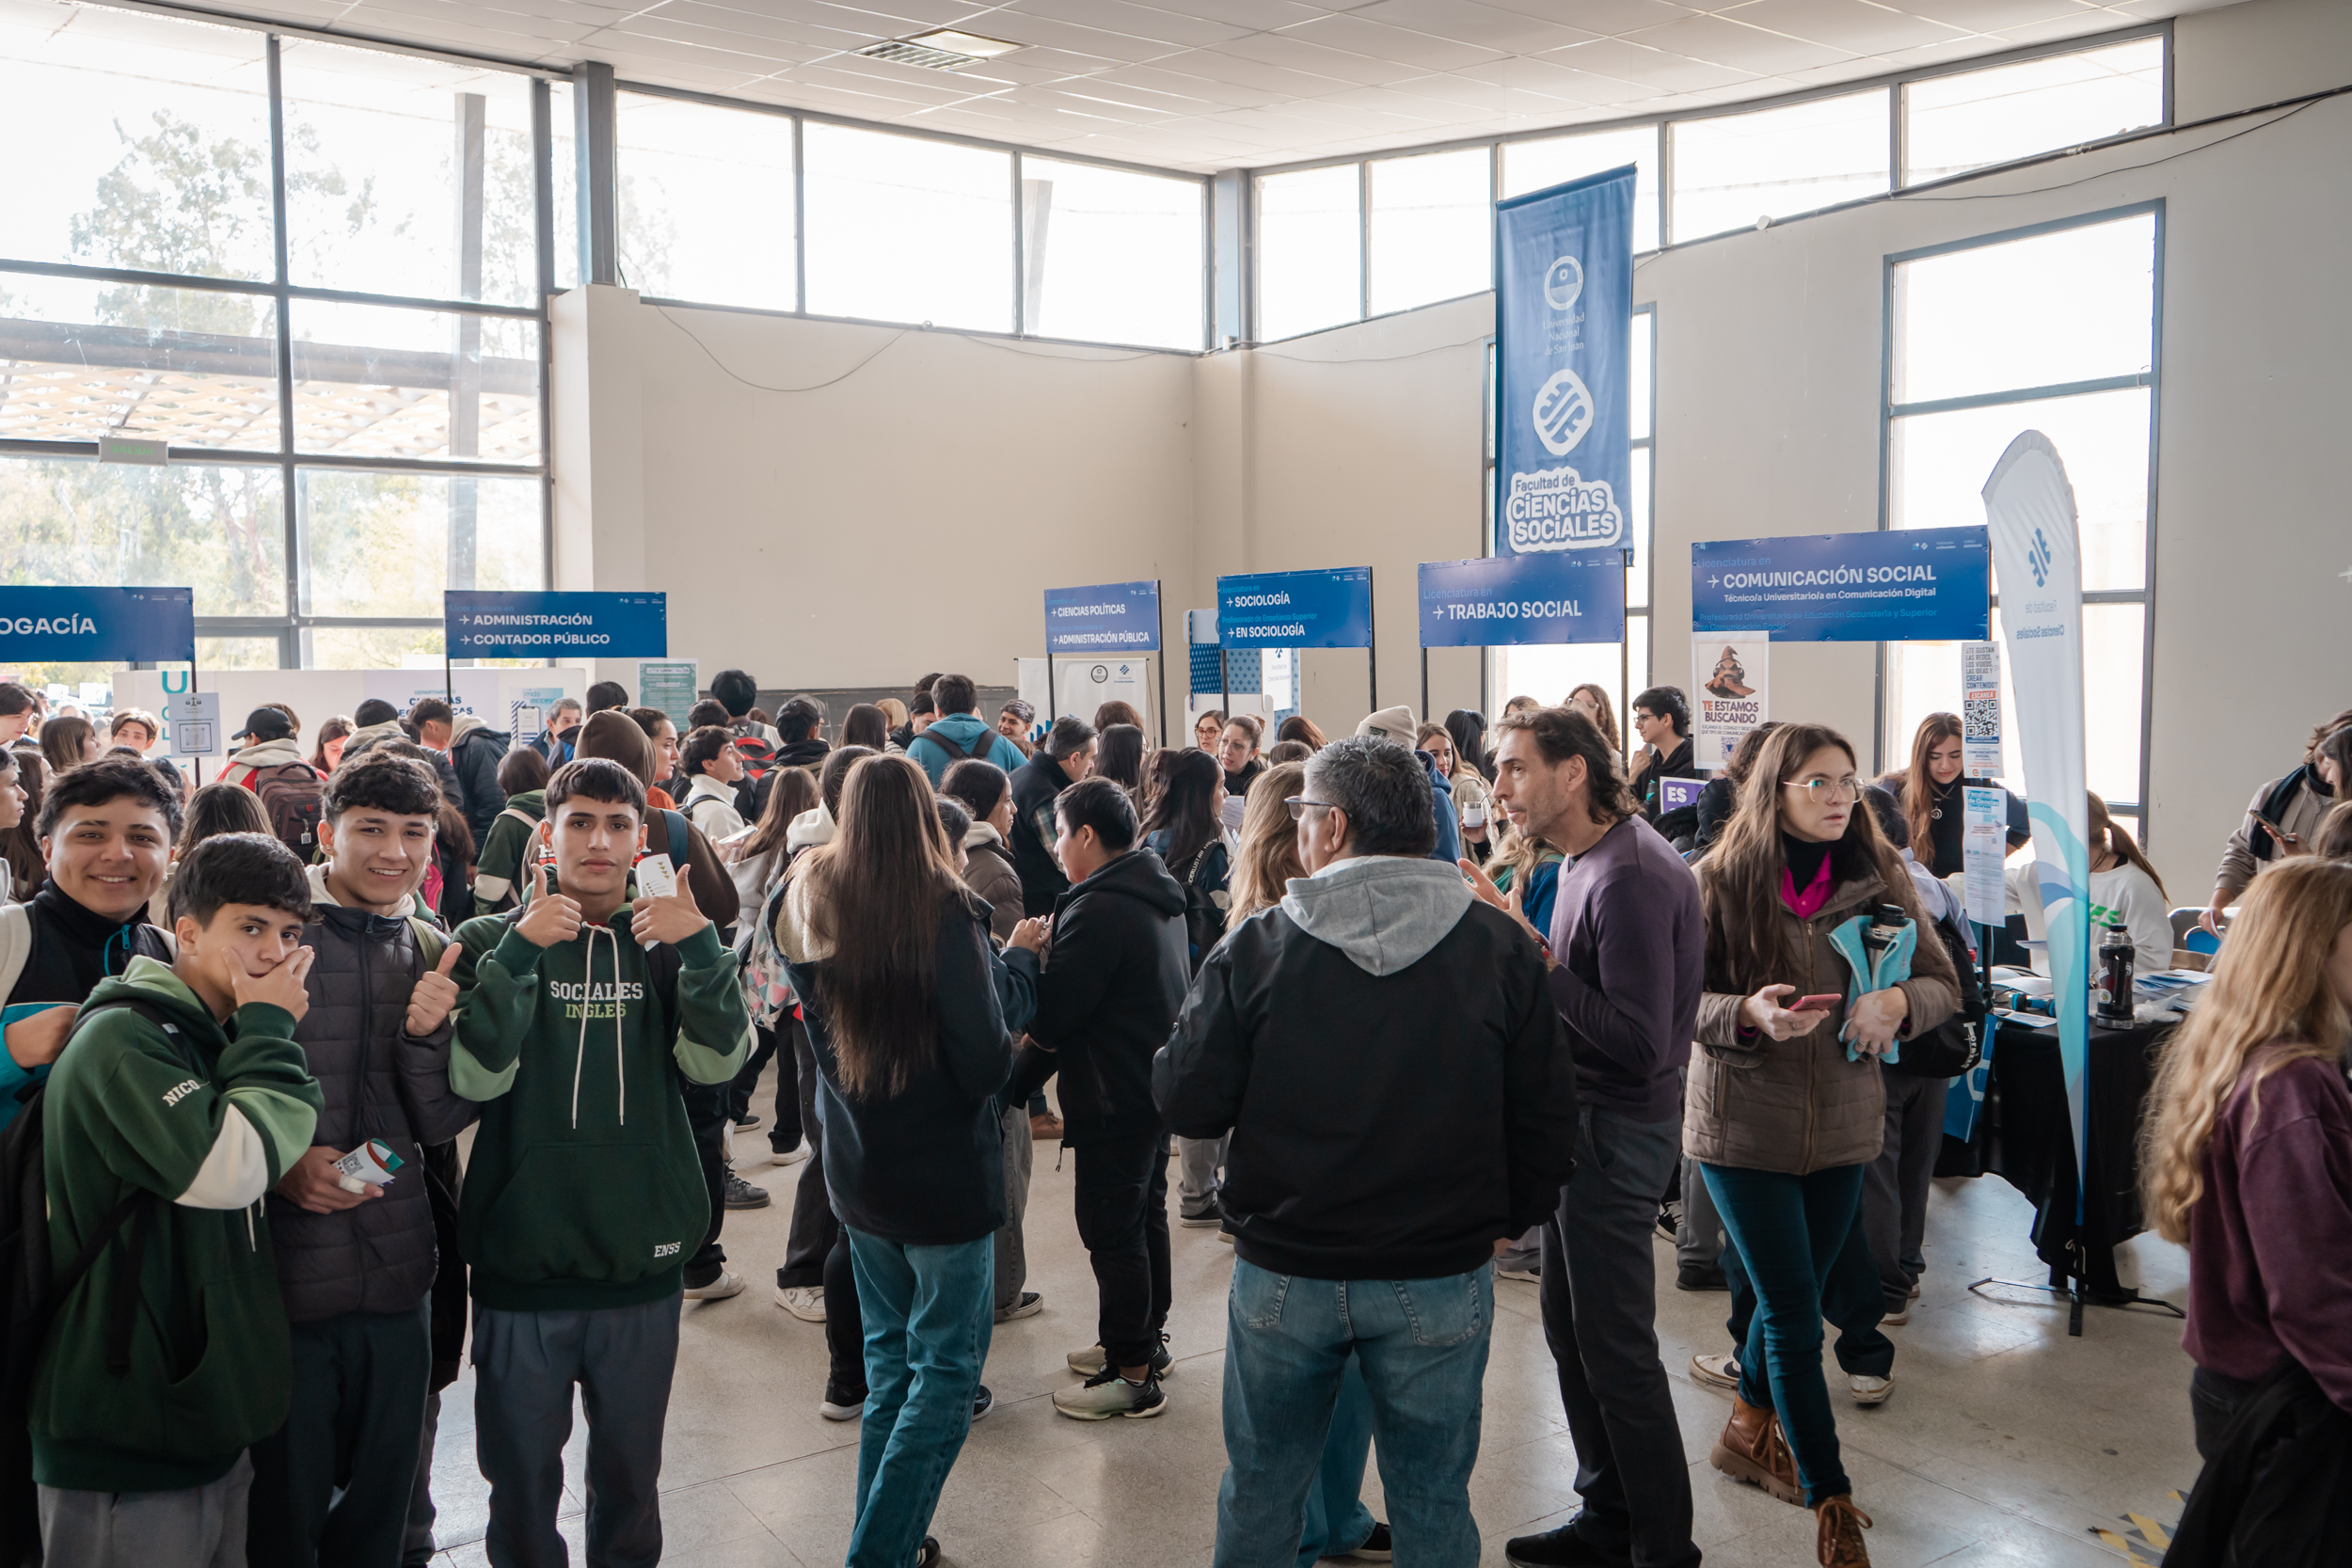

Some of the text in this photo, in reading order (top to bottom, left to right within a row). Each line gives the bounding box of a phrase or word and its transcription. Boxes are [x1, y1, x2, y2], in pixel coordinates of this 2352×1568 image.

[1543, 311, 1584, 329] Universidad
[1549, 326, 1580, 341] Nacional
[1545, 341, 1584, 356] de San Juan
[111, 444, 154, 455] SALIDA
[1516, 474, 1575, 492] Facultad de
[1696, 557, 1771, 569] Licenciatura en
[1724, 565, 1936, 588] COMUNICACIÓN SOCIAL
[1234, 591, 1290, 608] SOCIOLOGÍA
[1423, 588, 1479, 599] Licenciatura
[1724, 592, 1762, 603] Técnico/a
[1764, 590, 1824, 602] Universitario/a
[1838, 589, 1903, 599] Comunicación
[1905, 587, 1936, 599] Digital
[1057, 603, 1125, 617] CIENCIAS POLÍTICAS
[1292, 612, 1317, 621] Superior
[1448, 600, 1582, 620] TRABAJO SOCIAL
[1700, 612, 1742, 621] Profesorado
[1744, 611, 1791, 621] Universitario
[1804, 610, 1844, 619] Educación
[1846, 610, 1892, 619] Secundaria
[1900, 609, 1937, 619] Superior
[473, 612, 593, 626] ADMINISTRACIÓN
[1709, 622, 1760, 631] Comunicación
[1762, 622, 1786, 631] Social
[1058, 630, 1150, 644] ADMINISTRACIÓN PÚBLICA
[1235, 622, 1305, 638] EN SOCIOLOGÍA
[473, 632, 610, 645] CONTADOR PÚBLICO
[1702, 701, 1758, 713] TE ESTAMOS
[1705, 712, 1756, 724] BUSCANDO
[1667, 786, 1687, 803] ES
[550, 980, 644, 1001] SOCIALES
[565, 1003, 627, 1018] INGLES
[162, 1079, 200, 1107] NICO
[654, 1242, 681, 1258] ENSS
